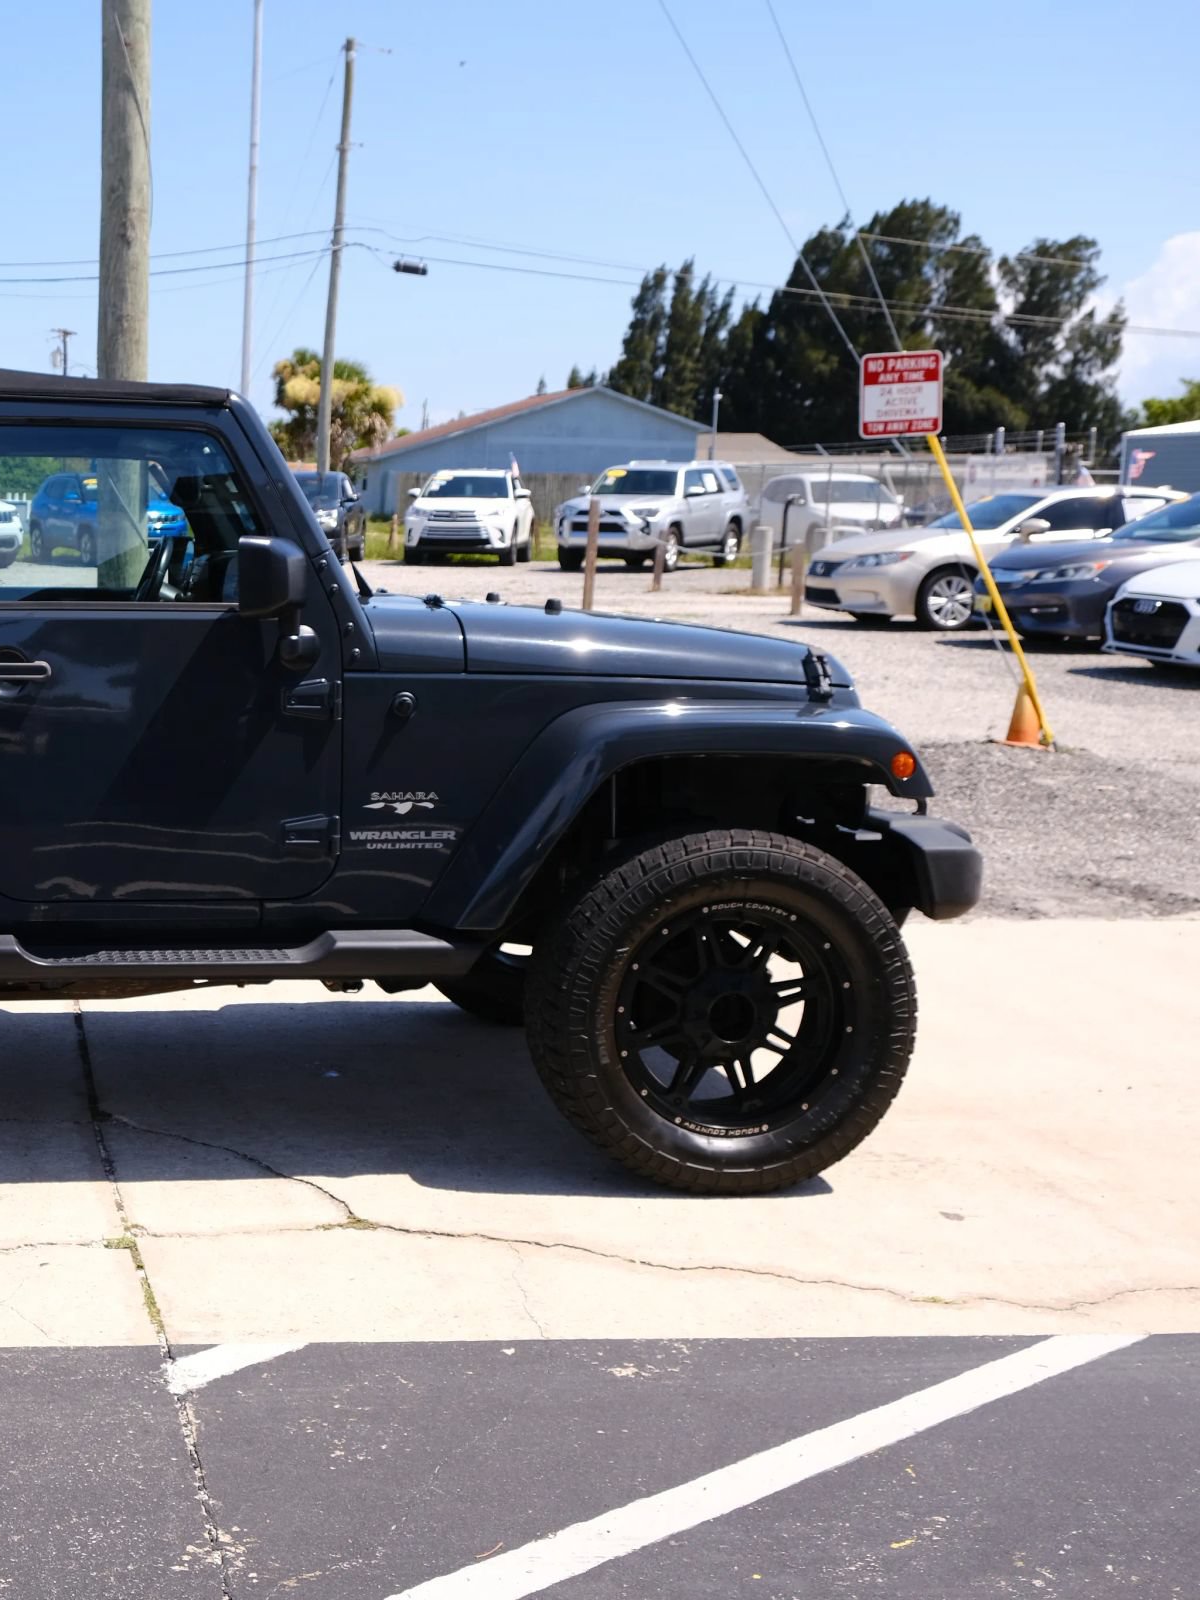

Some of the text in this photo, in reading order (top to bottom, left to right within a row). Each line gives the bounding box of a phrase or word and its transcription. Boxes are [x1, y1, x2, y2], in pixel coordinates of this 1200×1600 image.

[867, 356, 936, 373] NO PARKING
[878, 370, 925, 383] ANY TIME
[885, 397, 917, 406] ACTIVE
[876, 408, 925, 417] DRIVEWAY
[867, 420, 934, 433] TOW AWAY ZONE
[370, 792, 439, 800] SAHARA
[349, 830, 456, 840] WRANGLER
[711, 902, 788, 916] ROUGH COUNTRY
[683, 1122, 760, 1136] ROUGH COUNTRY
